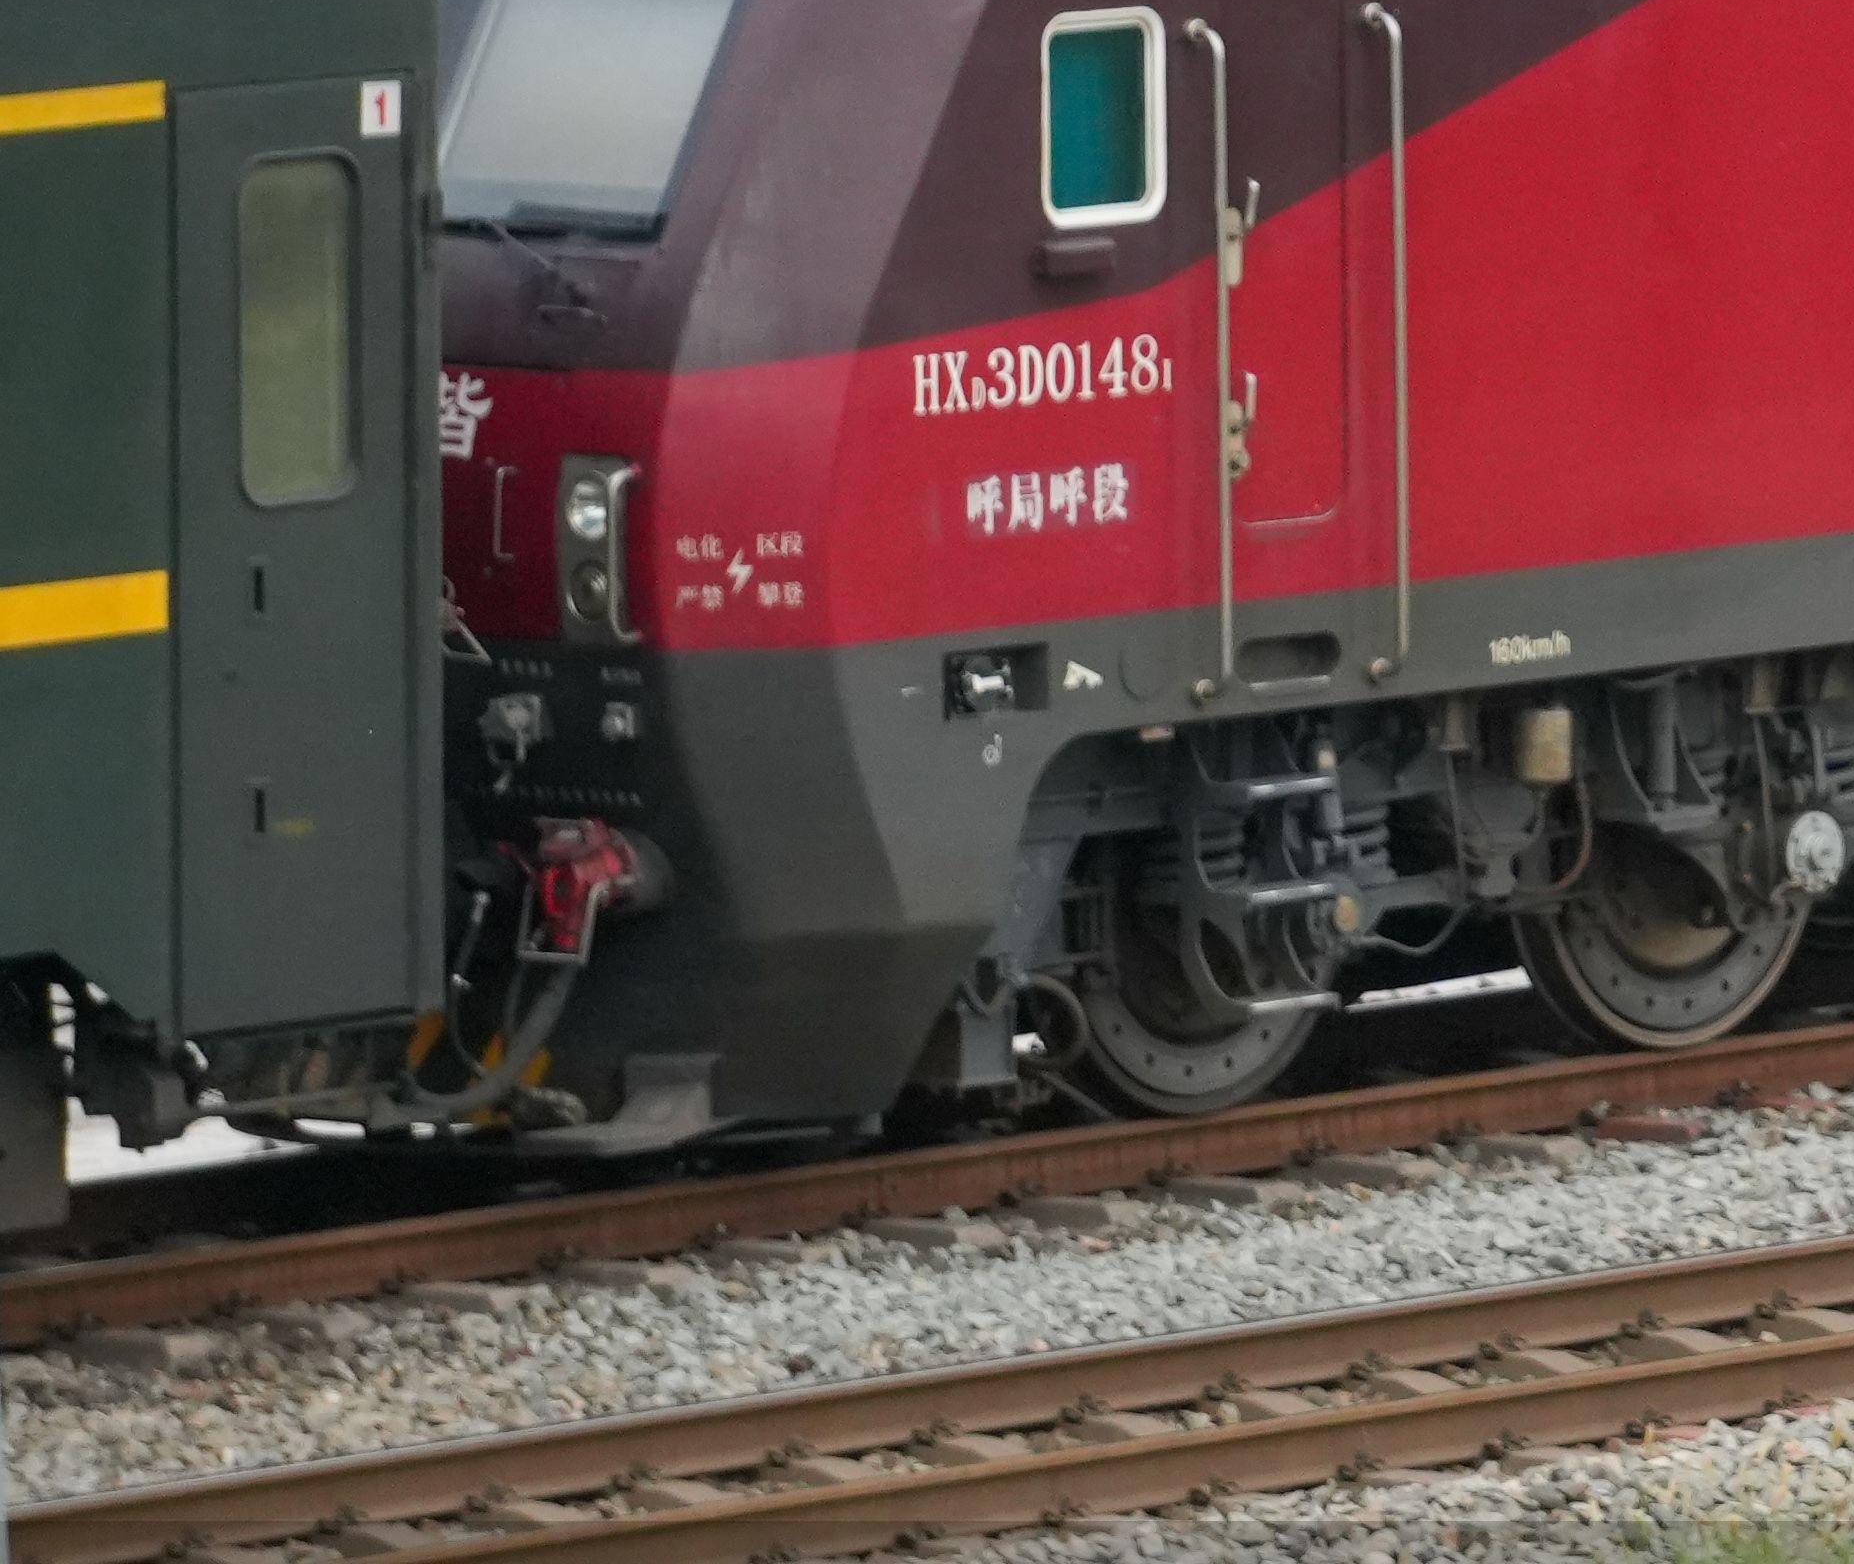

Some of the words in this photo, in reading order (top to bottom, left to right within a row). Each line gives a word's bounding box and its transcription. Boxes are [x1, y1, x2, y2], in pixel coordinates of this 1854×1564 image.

[374, 89, 385, 126] 1
[966, 462, 1129, 534] 呼局呼段
[676, 534, 724, 560] 电化
[756, 531, 803, 557] 区段
